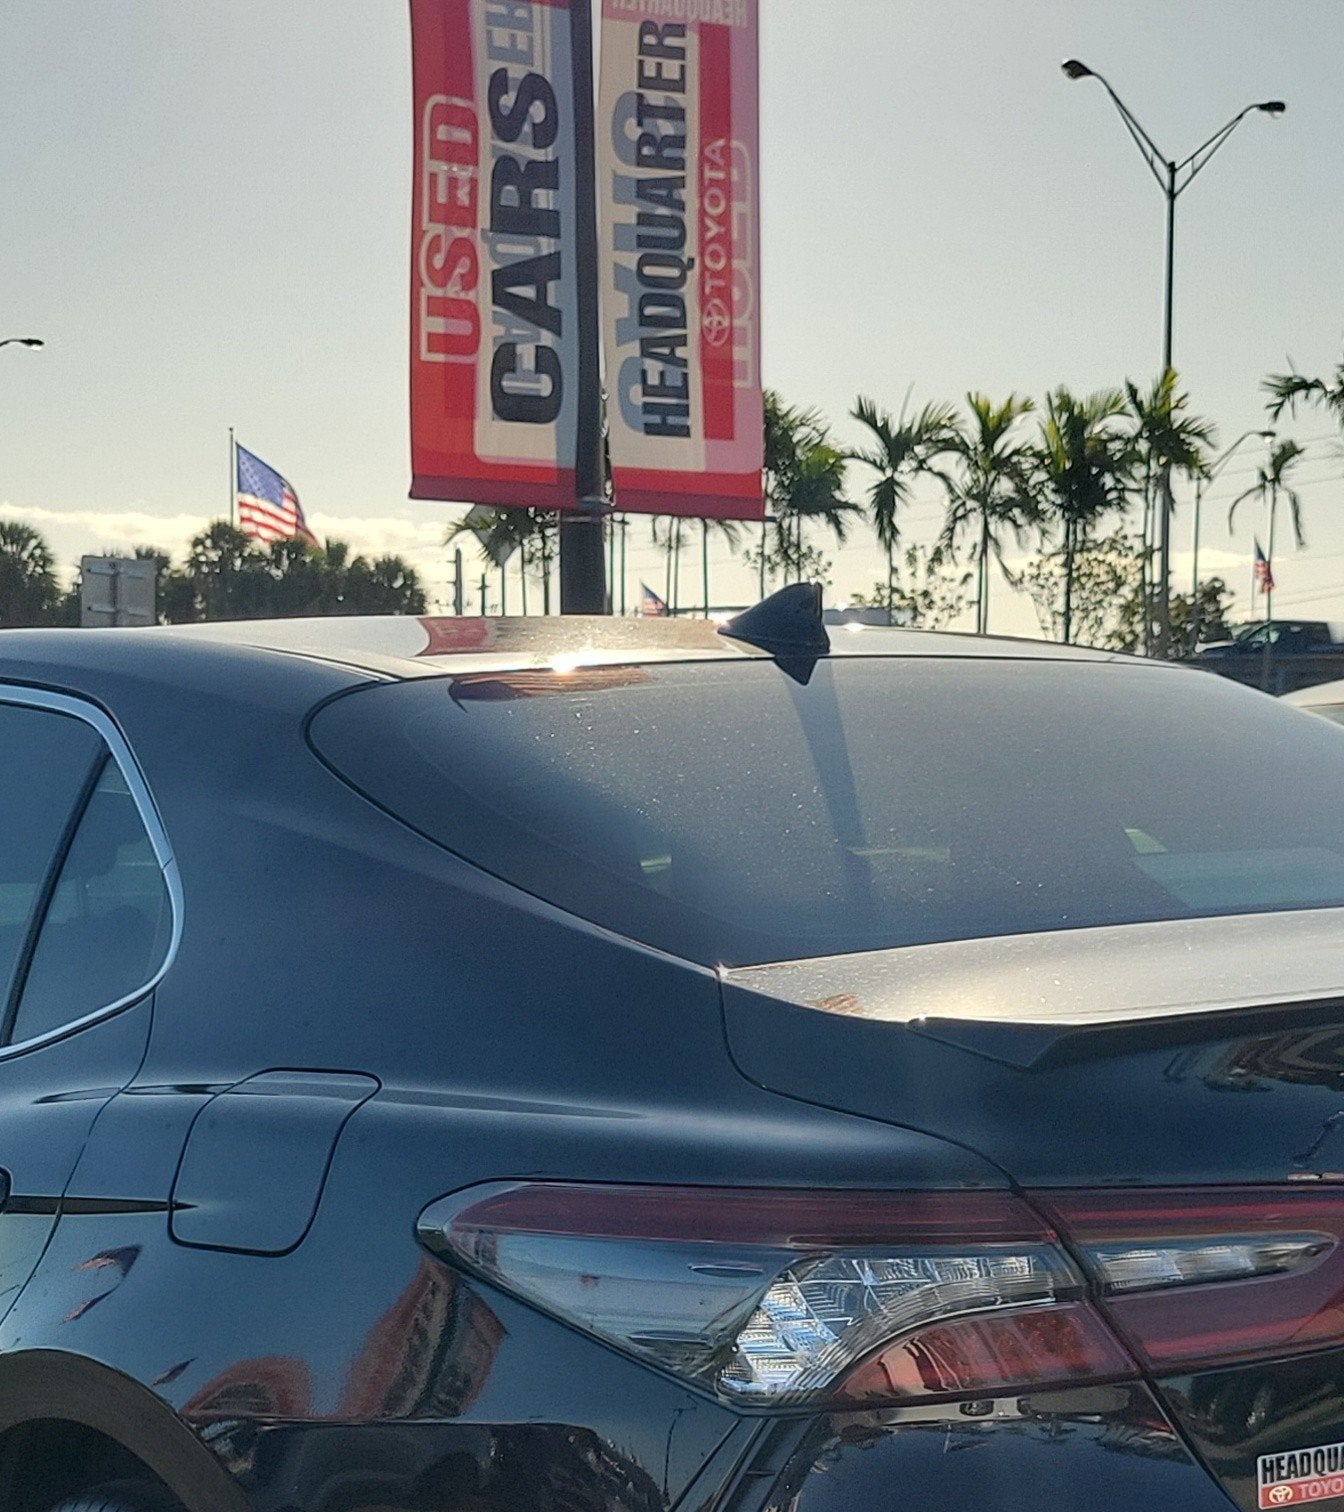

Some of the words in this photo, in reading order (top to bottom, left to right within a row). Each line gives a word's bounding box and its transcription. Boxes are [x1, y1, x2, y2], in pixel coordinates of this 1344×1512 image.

[419, 94, 481, 364] USED
[487, 67, 562, 424] CARS
[636, 20, 695, 437] HEADQUARTER
[703, 138, 728, 297] TOYOTA
